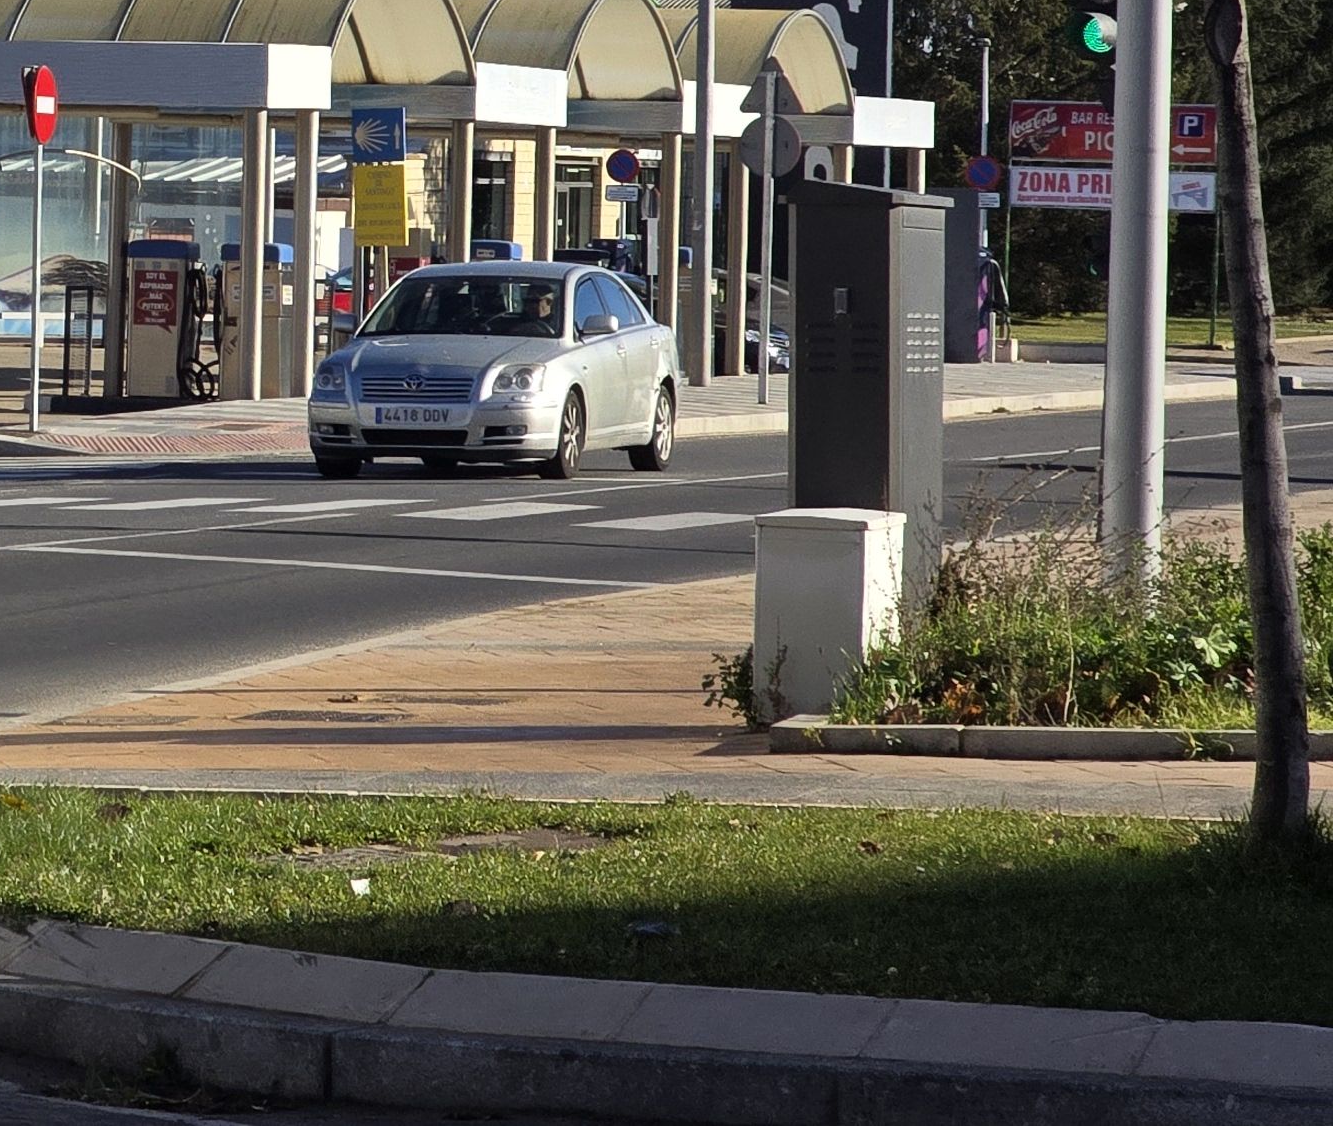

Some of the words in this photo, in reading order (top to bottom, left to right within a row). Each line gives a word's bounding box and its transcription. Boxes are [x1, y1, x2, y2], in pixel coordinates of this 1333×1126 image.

[1071, 111, 1093, 125] BAR
[1183, 115, 1200, 136] P
[1018, 171, 1071, 193] ZONA
